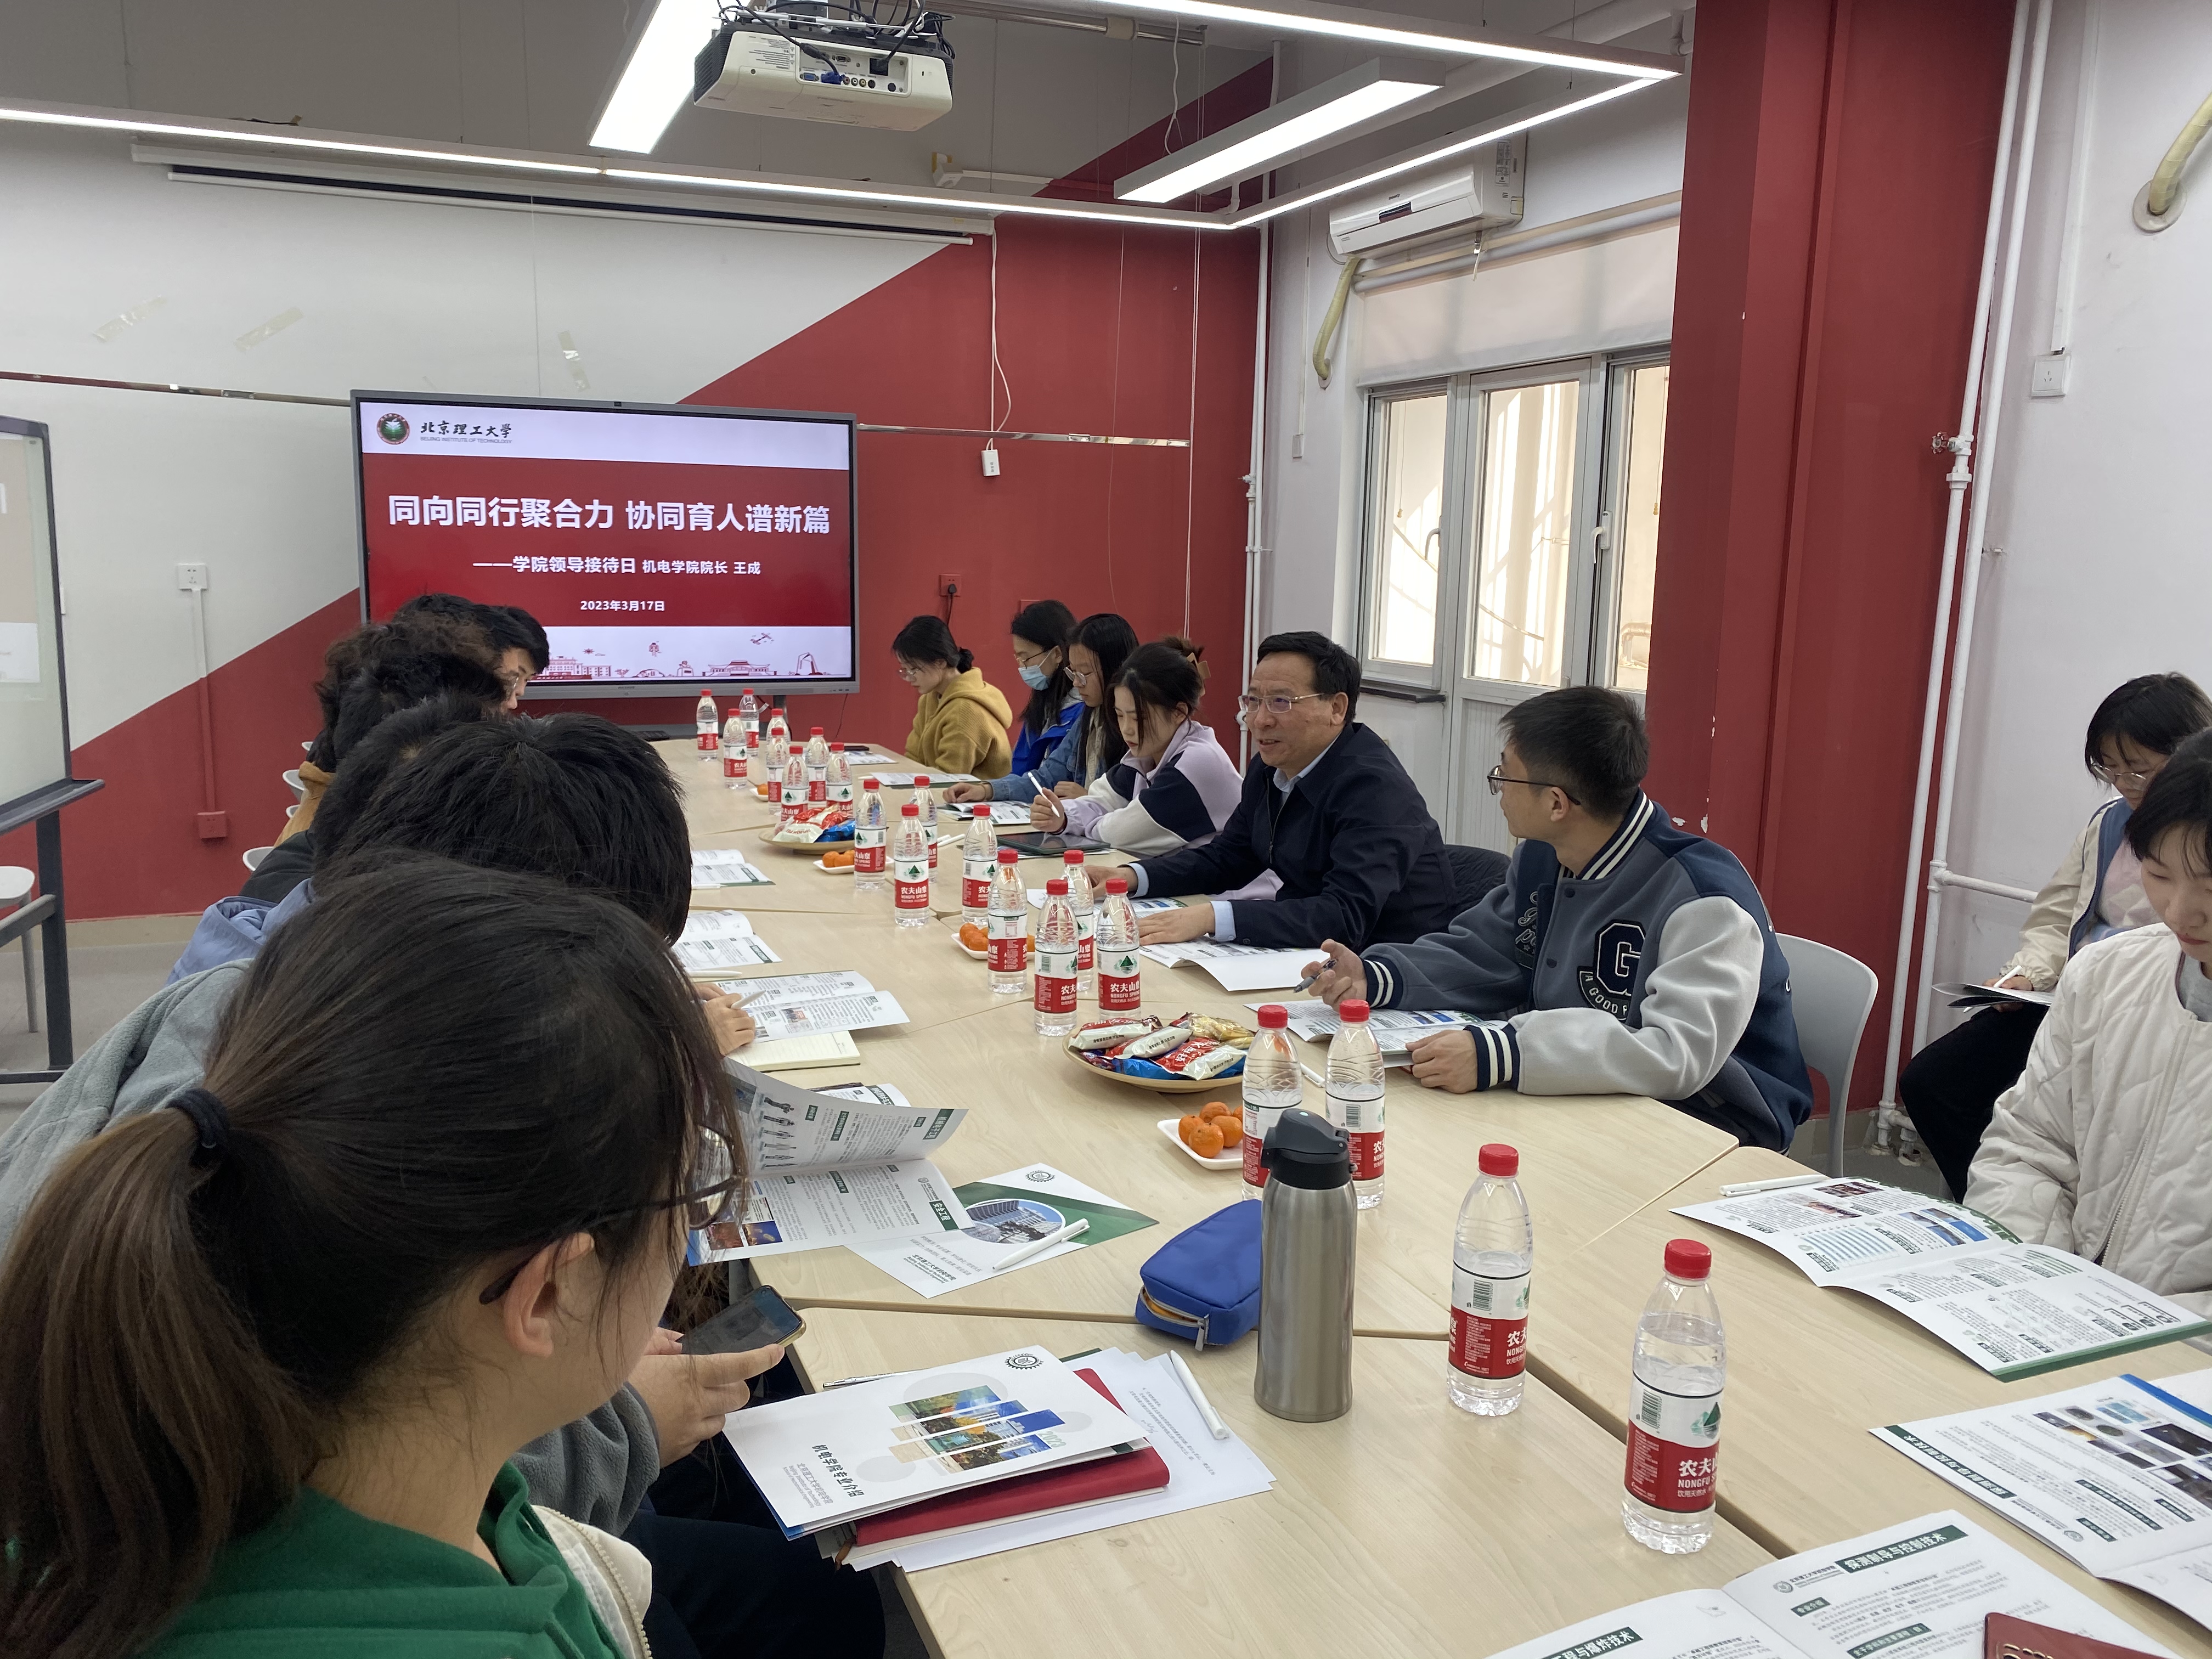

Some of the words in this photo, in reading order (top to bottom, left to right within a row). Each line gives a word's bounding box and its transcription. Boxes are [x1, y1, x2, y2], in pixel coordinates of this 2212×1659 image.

[388, 494, 614, 529] 同向同行聚合力
[625, 500, 830, 534] 协同育人谱新篇
[642, 558, 728, 575] 机电学院院长
[733, 561, 761, 575] 王成
[580, 600, 665, 612] 2023年3月17日
[901, 885, 927, 895] 农夫山泉
[1589, 987, 1618, 1014] GOOD
[933, 1203, 951, 1221] 安全工程
[1039, 1431, 1066, 1448] 2023
[812, 1444, 865, 1497] 机电学院专业介绍
[1903, 1434, 2008, 1496] 探测制导与控制技术
[797, 1463, 833, 1505] 北京理工大学机电学院
[1678, 1476, 1711, 1488] NONGFU
[1844, 1532, 1947, 1570] 探测制导与控制技术
